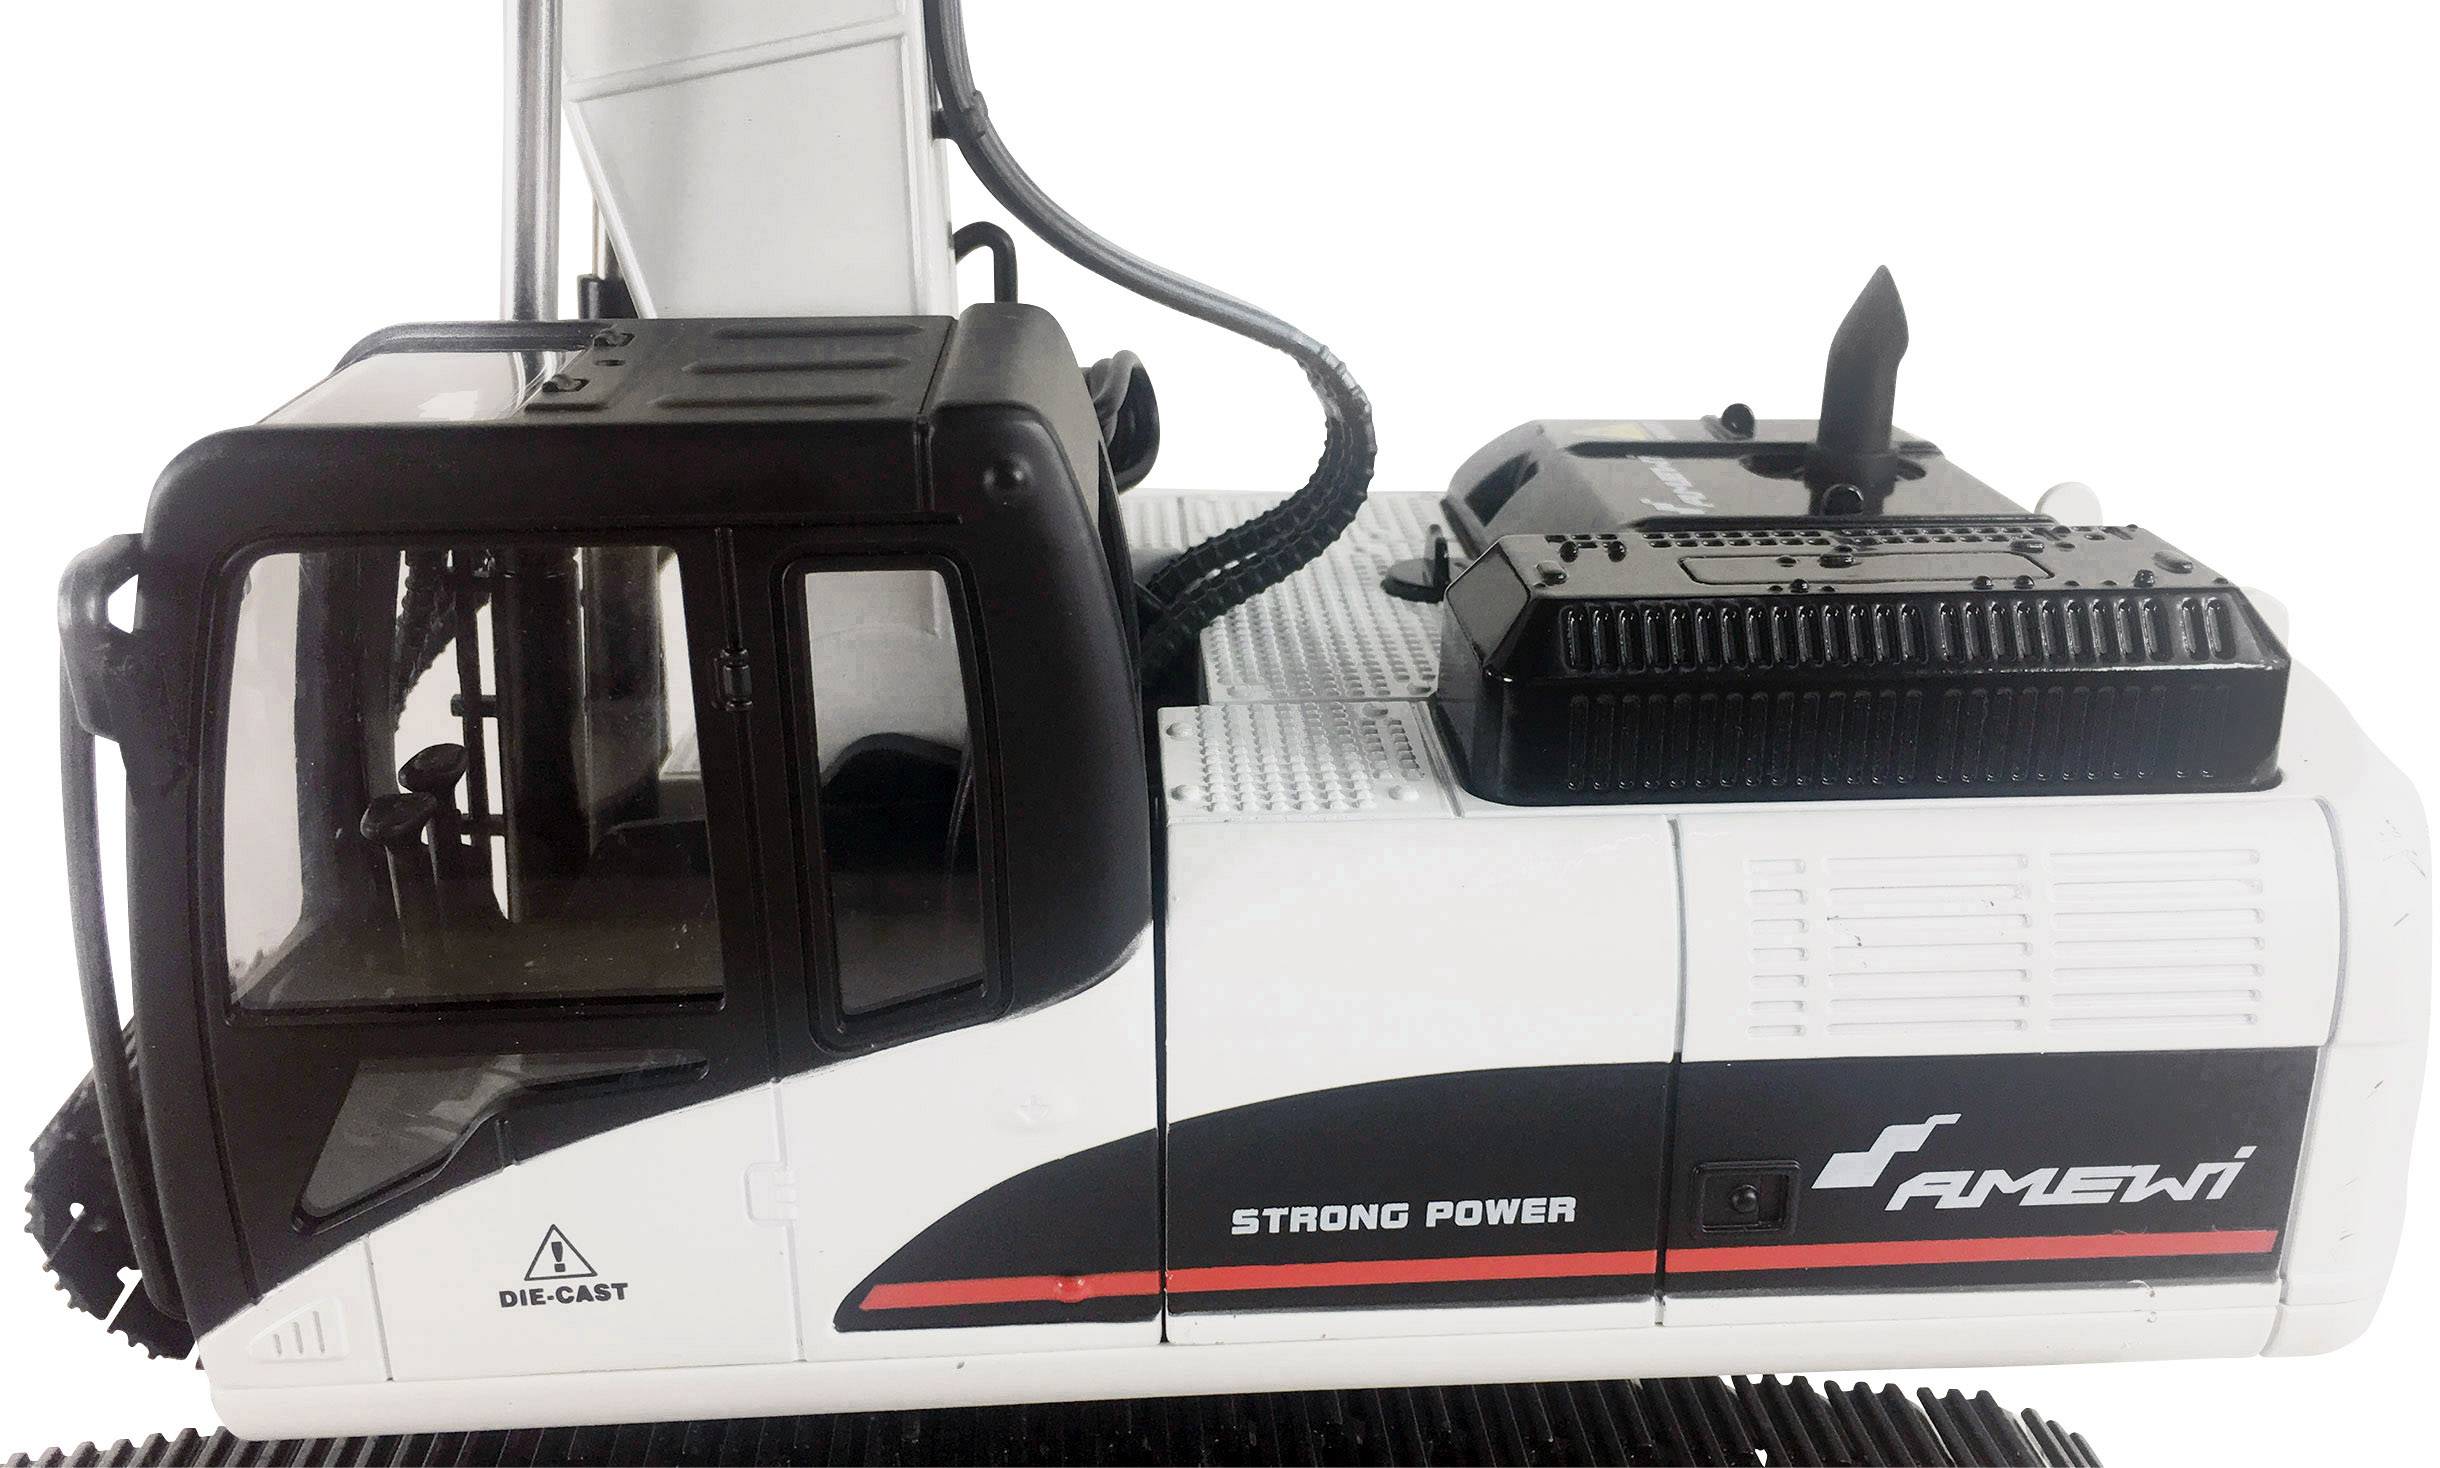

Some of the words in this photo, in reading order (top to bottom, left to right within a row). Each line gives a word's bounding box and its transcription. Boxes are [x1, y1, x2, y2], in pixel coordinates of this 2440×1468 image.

[1231, 1203, 1410, 1236] STRONG
[1425, 1196, 1577, 1228] POWER
[498, 1282, 629, 1308] DIE-CAST
